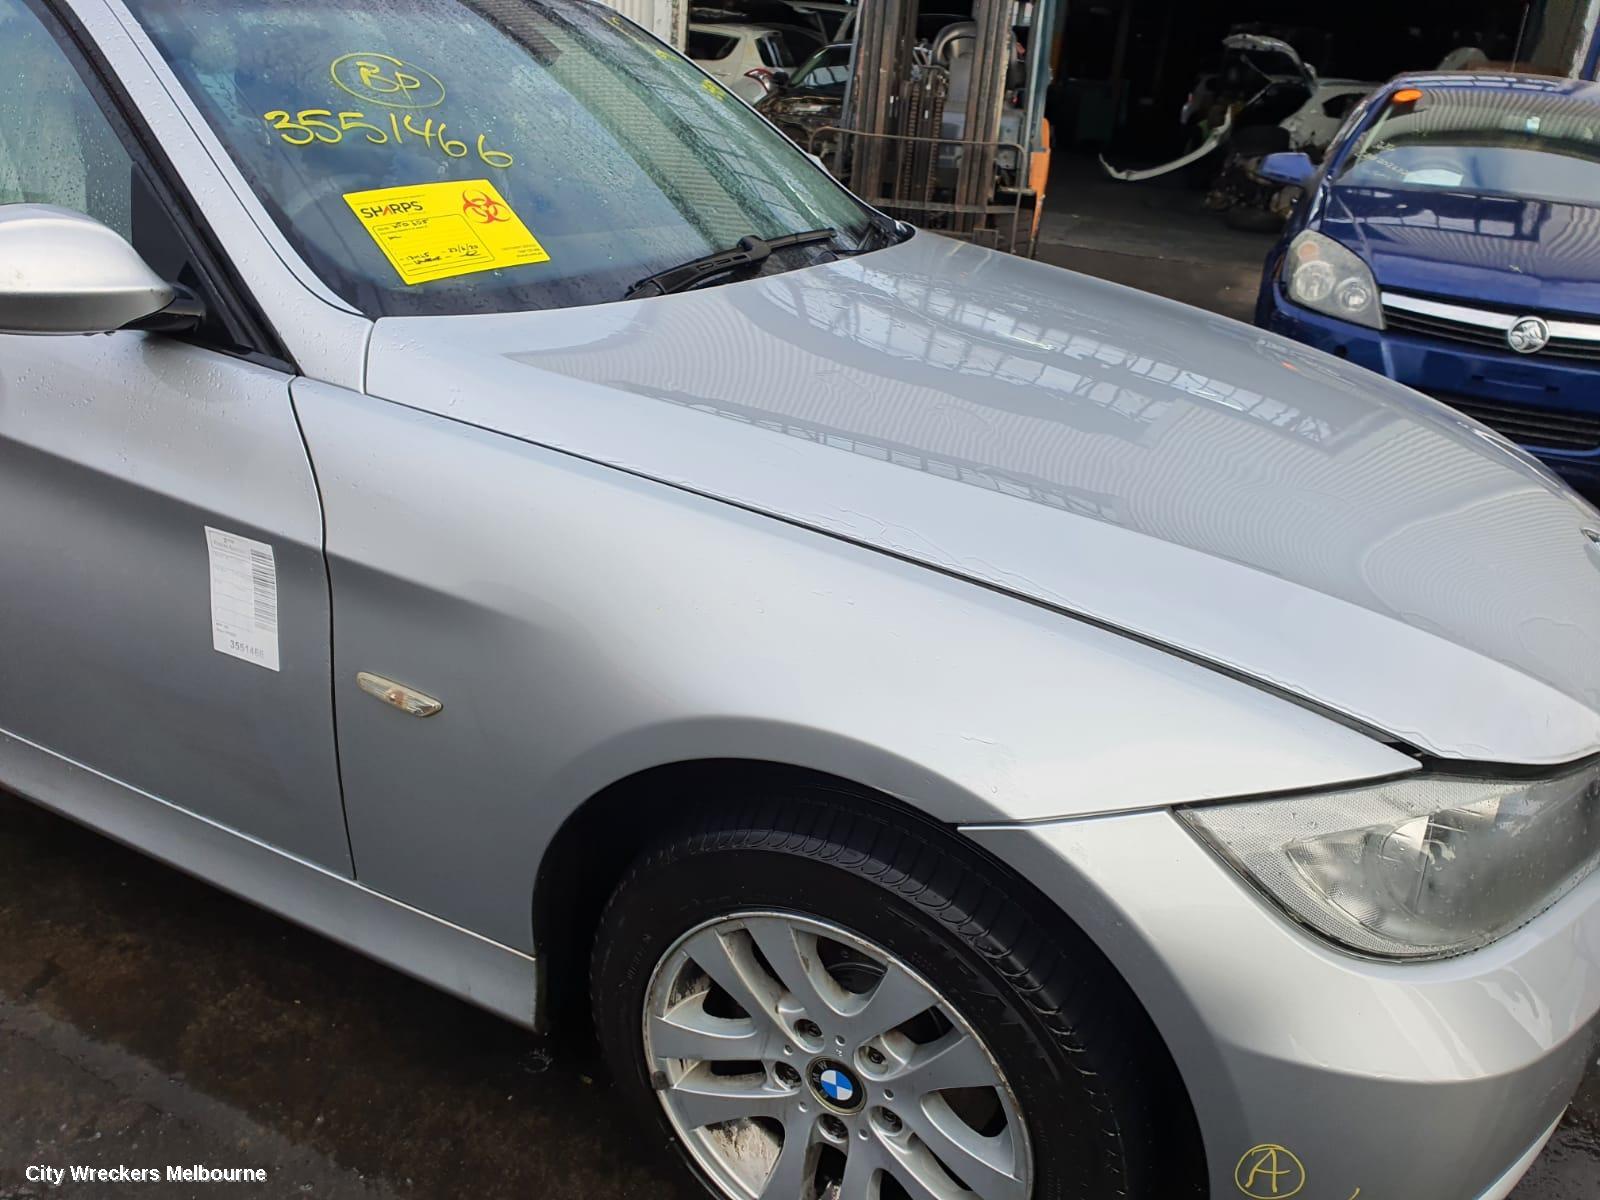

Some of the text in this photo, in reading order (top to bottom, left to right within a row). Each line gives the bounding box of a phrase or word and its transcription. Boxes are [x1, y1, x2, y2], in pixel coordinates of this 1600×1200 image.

[263, 109, 514, 168] 3551466
[360, 200, 424, 219] SHARPS
[1245, 1148, 1291, 1193] A
